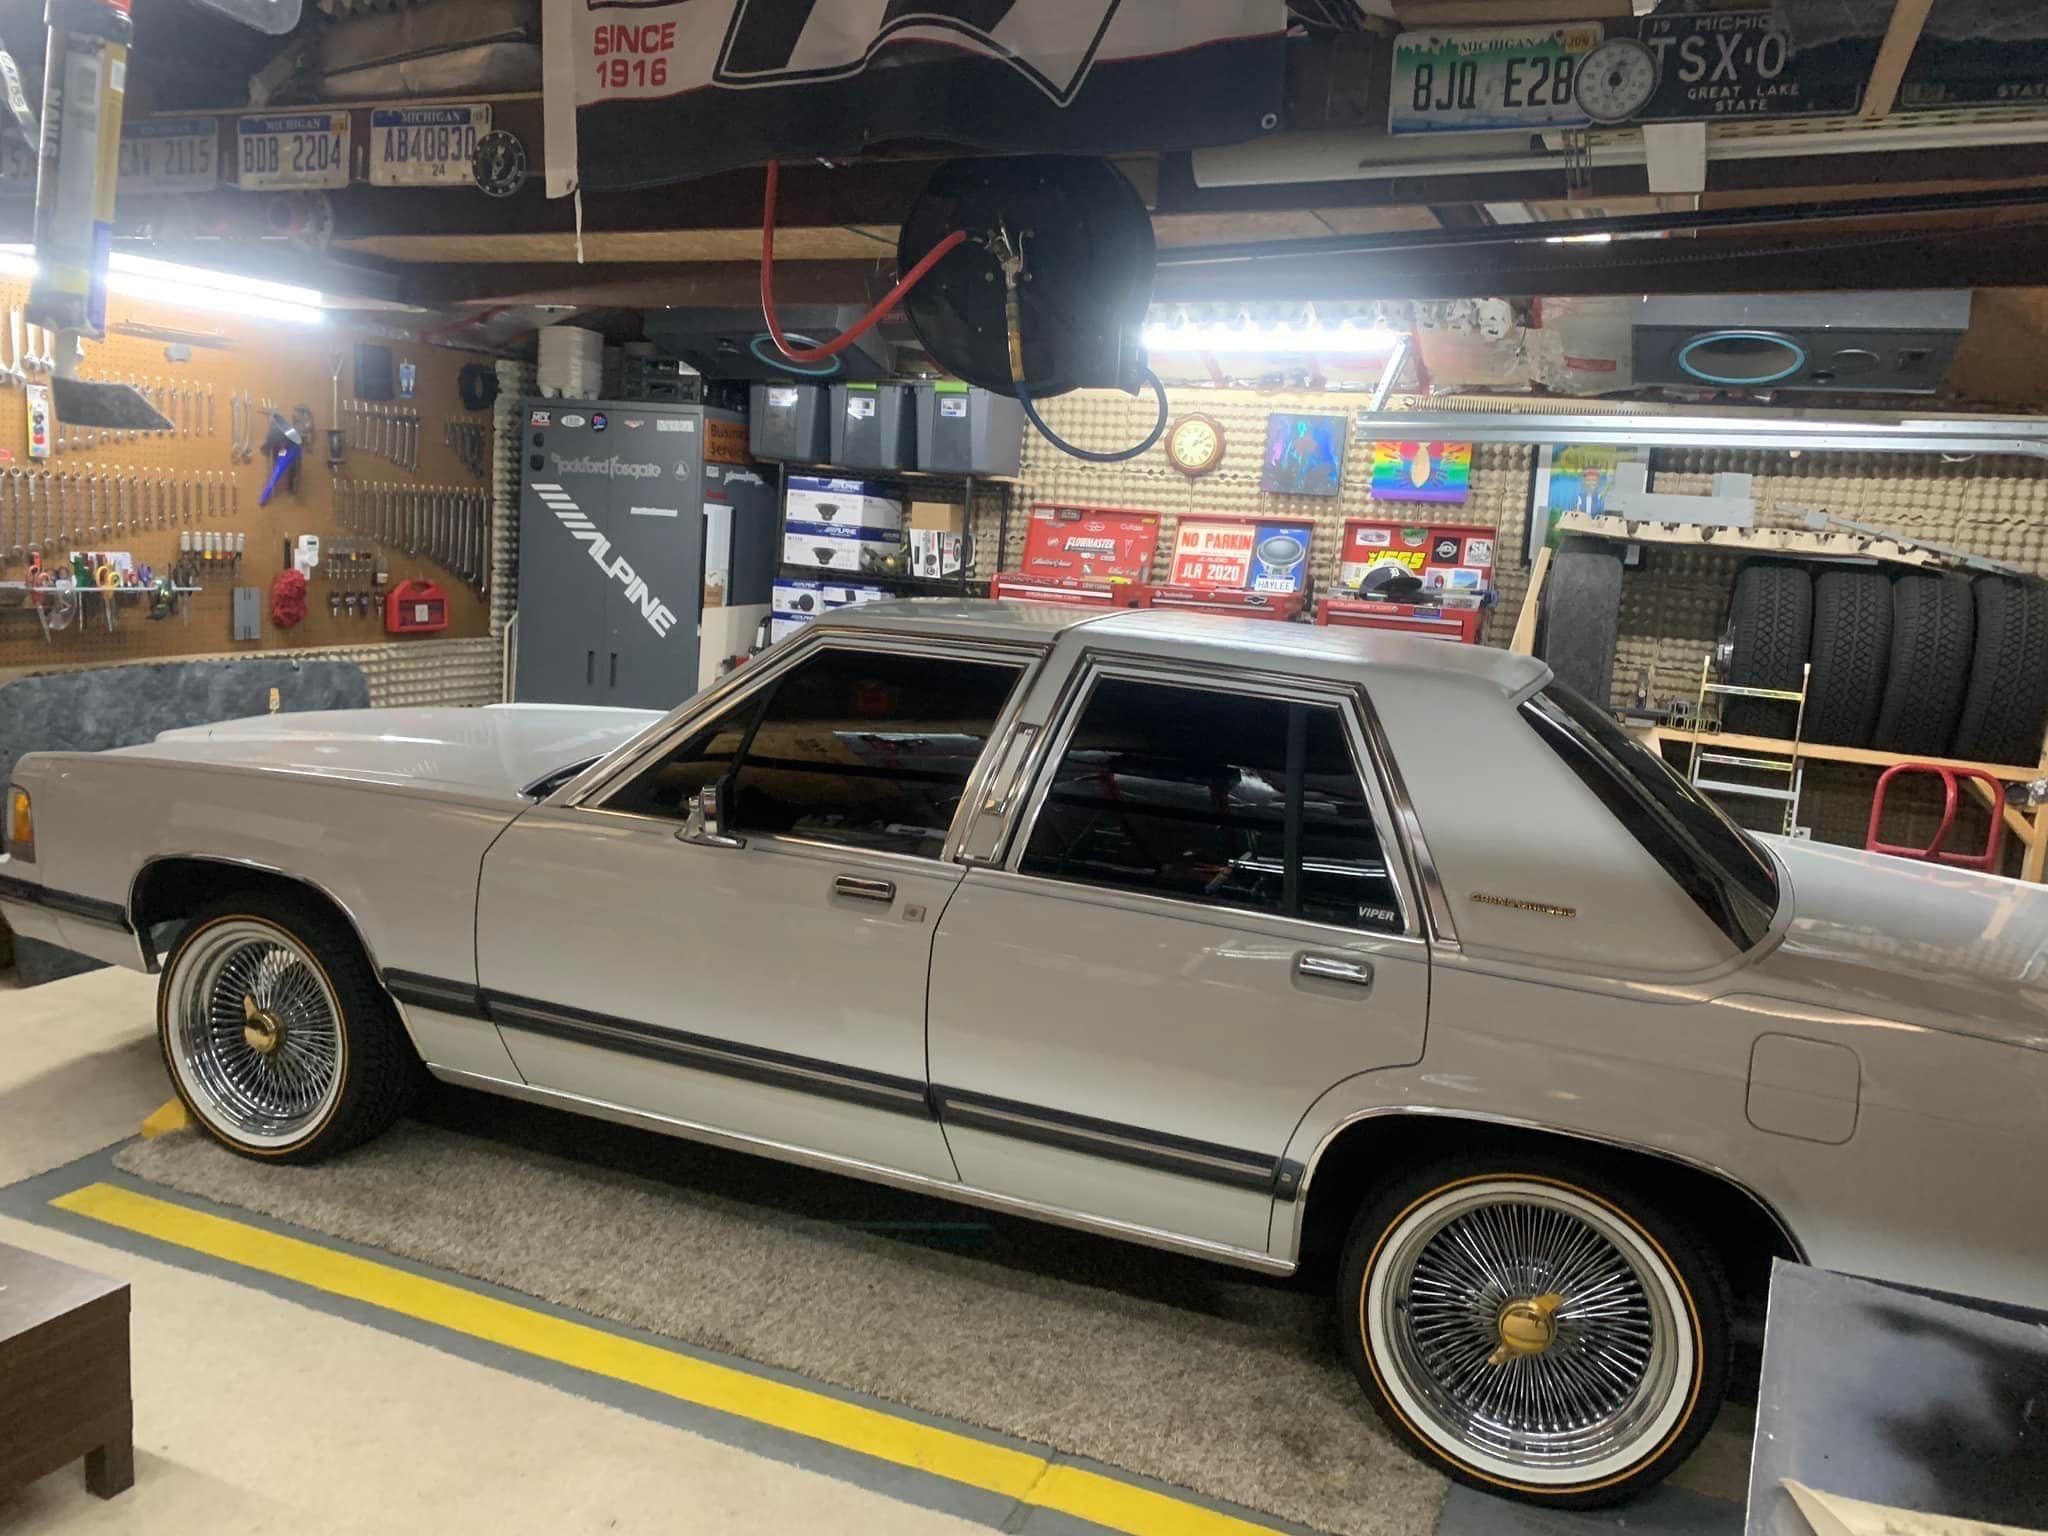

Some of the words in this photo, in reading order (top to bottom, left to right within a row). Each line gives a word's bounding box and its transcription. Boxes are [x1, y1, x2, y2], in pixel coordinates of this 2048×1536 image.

[593, 21, 677, 56] SINCE
[1460, 37, 1536, 51] MICHIGAN
[596, 57, 667, 89] 1916
[1503, 55, 1575, 108] E28
[1687, 85, 1743, 100] GREAT
[1756, 83, 1800, 96] LAKE
[1714, 98, 1769, 112] STATE
[266, 117, 321, 130] MICHIGAN
[401, 110, 461, 123] MICHIGAN
[292, 133, 342, 172] 2204
[432, 164, 446, 177] 24
[1064, 536, 1116, 551] FLOWMASTER
[1181, 532, 1199, 548] NO
[1205, 533, 1253, 550] PARKIN
[1206, 563, 1241, 581] 2020
[1257, 579, 1291, 591] HAYLEE
[1357, 906, 1396, 922] VIPER
